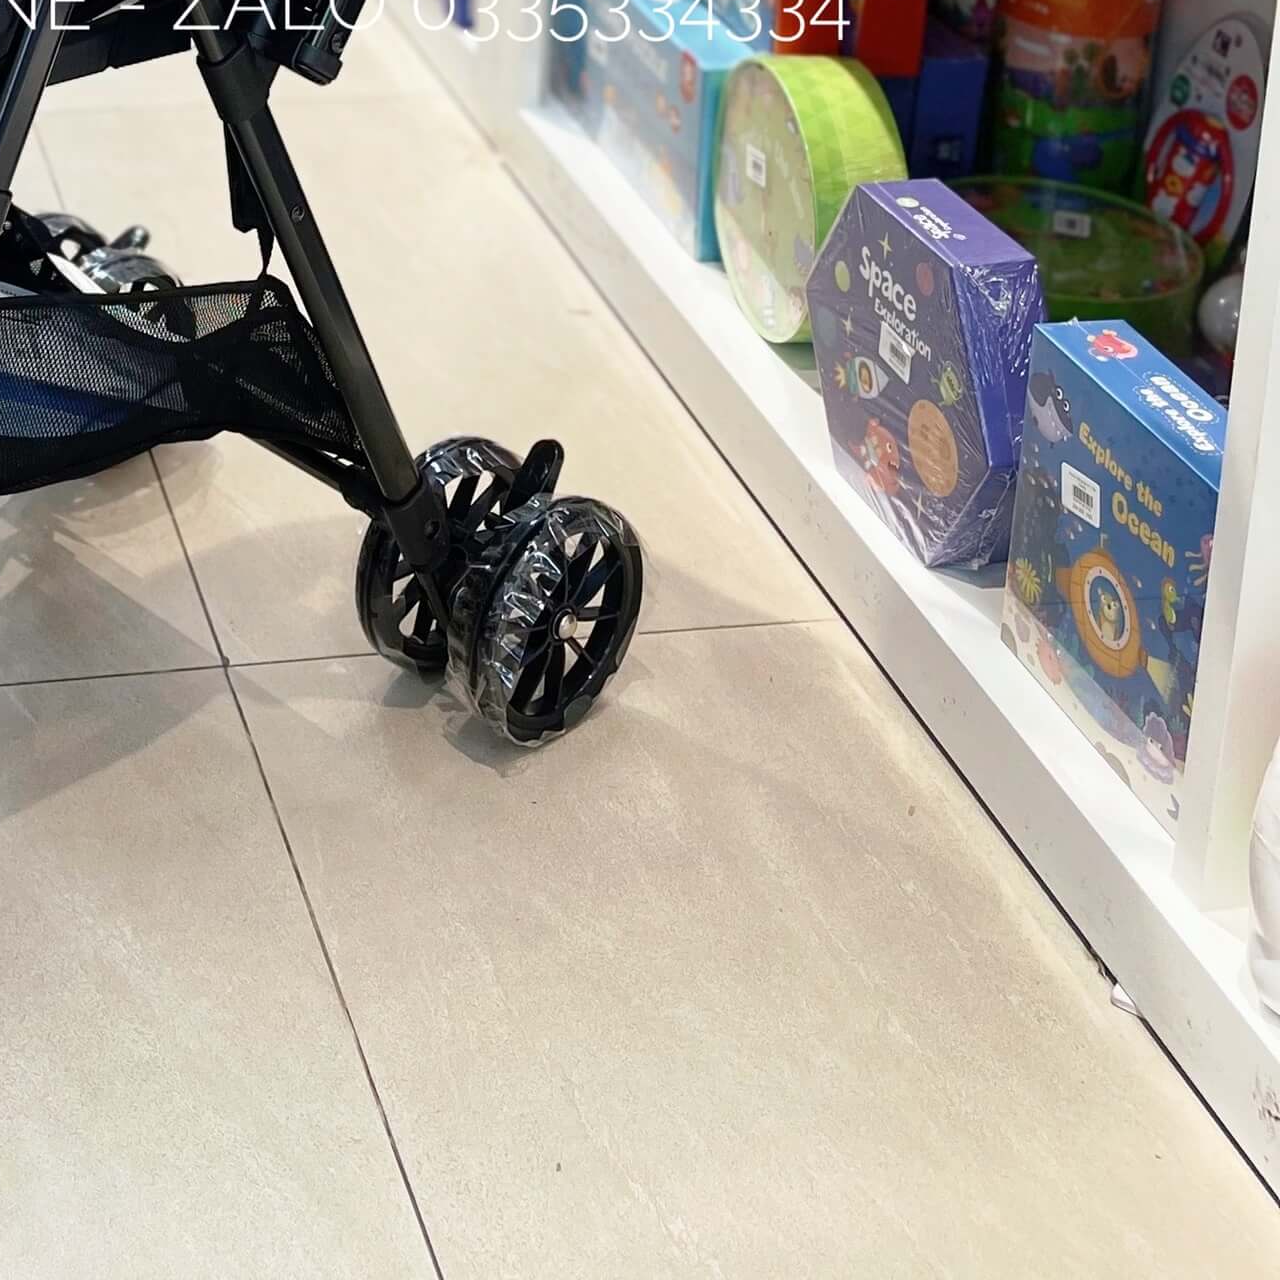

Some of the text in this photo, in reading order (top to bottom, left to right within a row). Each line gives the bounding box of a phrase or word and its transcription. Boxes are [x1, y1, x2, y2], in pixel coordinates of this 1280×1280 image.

[859, 246, 917, 321] Space
[874, 297, 932, 362] Exploration
[1079, 421, 1133, 491] Explore
[1136, 480, 1163, 517] the
[1111, 491, 1176, 568] Ocean
